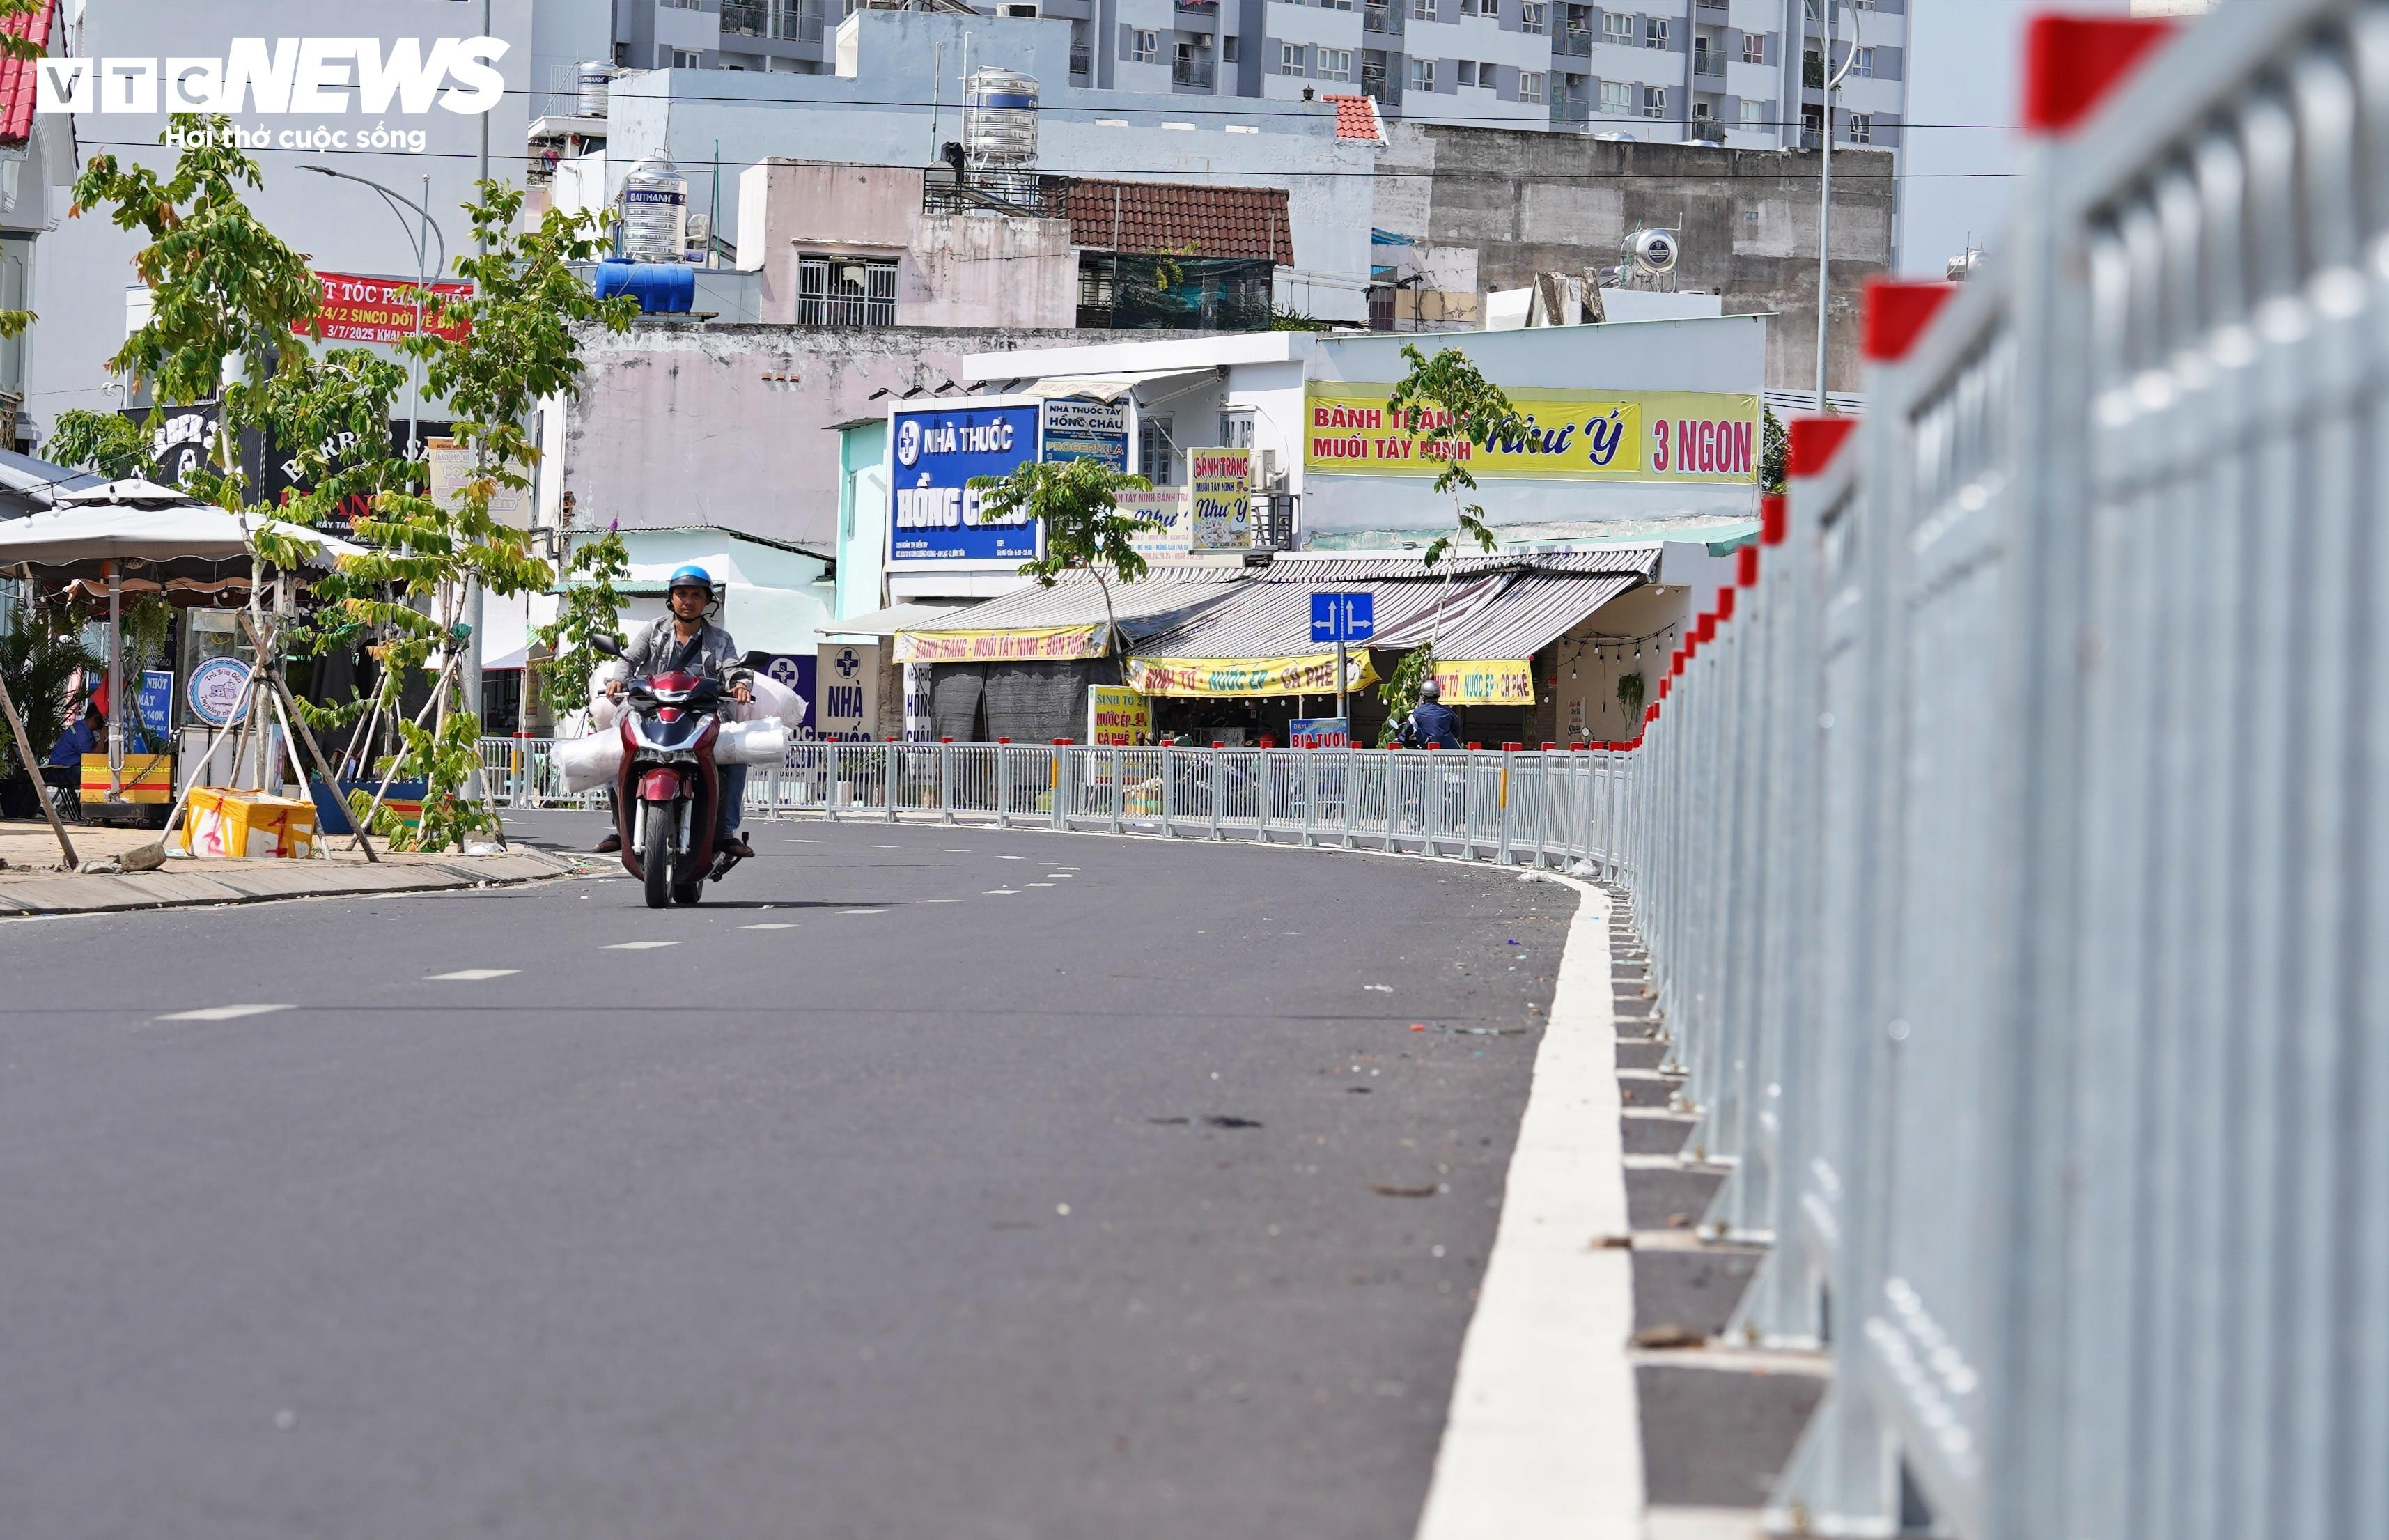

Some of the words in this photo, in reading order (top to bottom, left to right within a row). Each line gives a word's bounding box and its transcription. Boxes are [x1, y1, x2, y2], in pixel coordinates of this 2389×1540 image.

[341, 281, 377, 303] TÓC
[350, 309, 388, 325] SINCO
[327, 325, 374, 340] 3/7/2025
[1050, 405, 1069, 413] NHÀ
[1071, 405, 1103, 414] THUỐC
[1313, 404, 1382, 429] BÁNH
[1050, 414, 1085, 428] HỒNG
[1089, 418, 1123, 429] CHÂU
[924, 421, 957, 453] NHÀ
[960, 417, 1014, 451] THUỐC
[1312, 432, 1368, 458] MUỐI
[1375, 435, 1413, 460] TÂY
[1585, 408, 1624, 466] Ý
[1652, 419, 1670, 473] 3
[1676, 419, 1752, 474] NGON
[1194, 451, 1218, 479] BÁNH
[1220, 451, 1248, 479] TRÁNG
[1138, 493, 1155, 503] NINH
[1157, 491, 1175, 502] BÁNH
[1195, 479, 1210, 492] MUỐI
[1221, 481, 1234, 492] NINH
[897, 472, 961, 528] HỒNG
[1196, 498, 1231, 518] Như
[1234, 495, 1248, 522] Ý
[915, 636, 939, 659] BÁNH
[940, 635, 967, 658] TRÁNG
[974, 630, 997, 658] MUỐI
[999, 632, 1015, 657] TÂY
[1016, 636, 1038, 657] NINH
[1145, 668, 1175, 690] SINH
[1178, 665, 1201, 690] TỐ
[1208, 664, 1247, 691] NƯỚC
[1249, 663, 1269, 690] ÉP
[1280, 660, 1301, 689] CÀ
[1305, 660, 1334, 687] PHÊ
[1464, 666, 1483, 697] NƯỚC
[1512, 669, 1529, 697] PHÊ
[201, 694, 221, 716] Topping
[827, 680, 863, 717] NHÀ
[1097, 694, 1119, 705] SINH
[1123, 692, 1134, 706] TỐ
[1097, 710, 1119, 726] NƯỚC
[1121, 710, 1130, 726] ÉP
[1098, 729, 1109, 745] CÀ
[1316, 732, 1345, 747] TƯƠI
